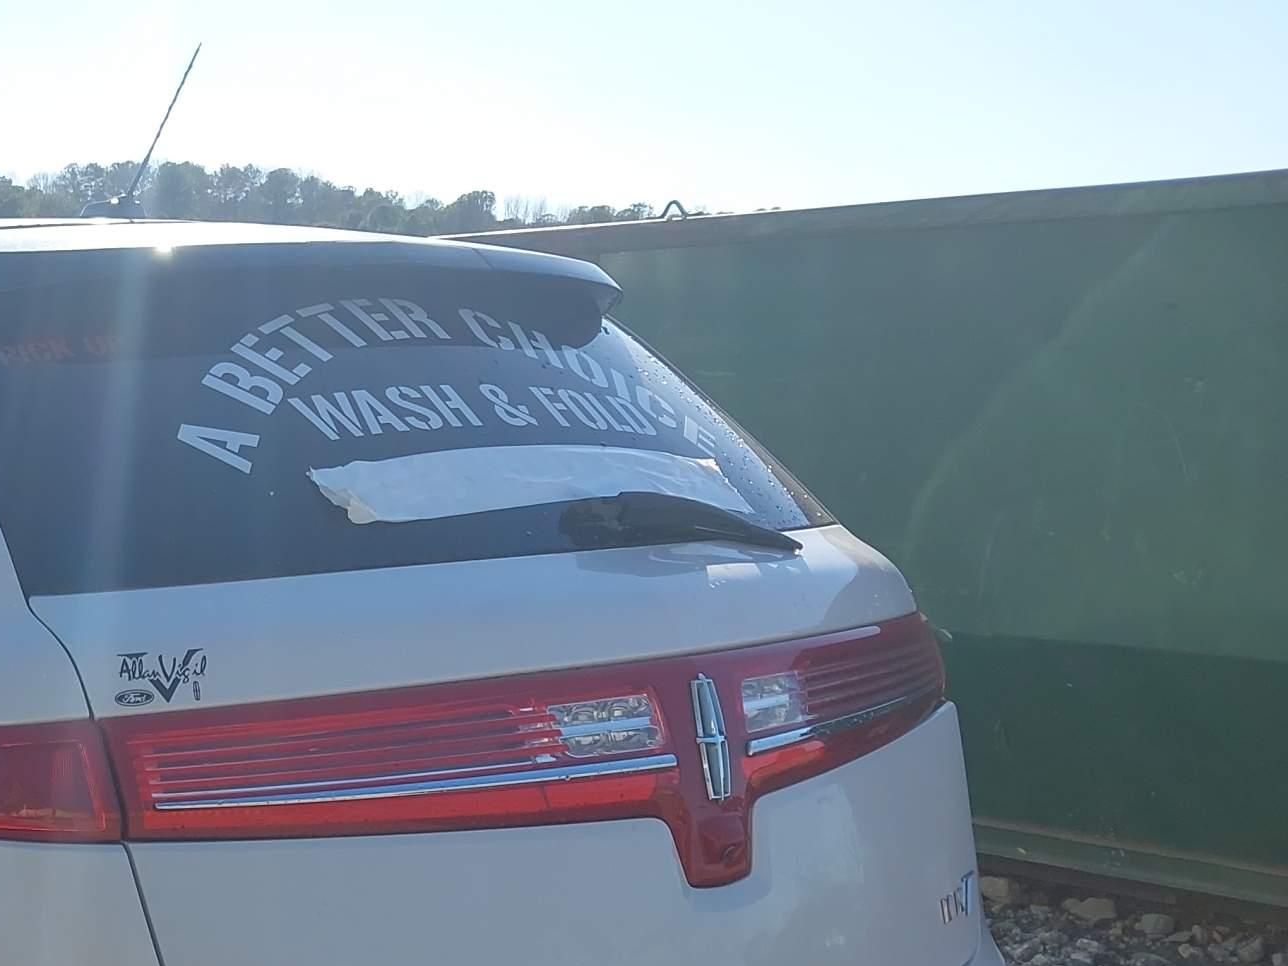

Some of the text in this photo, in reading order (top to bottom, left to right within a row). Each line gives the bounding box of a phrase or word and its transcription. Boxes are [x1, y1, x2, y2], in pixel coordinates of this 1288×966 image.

[177, 298, 716, 474] A BETTER CHOICE
[287, 384, 657, 441] WASH & FOLD
[117, 652, 207, 684] Allan Vigil
